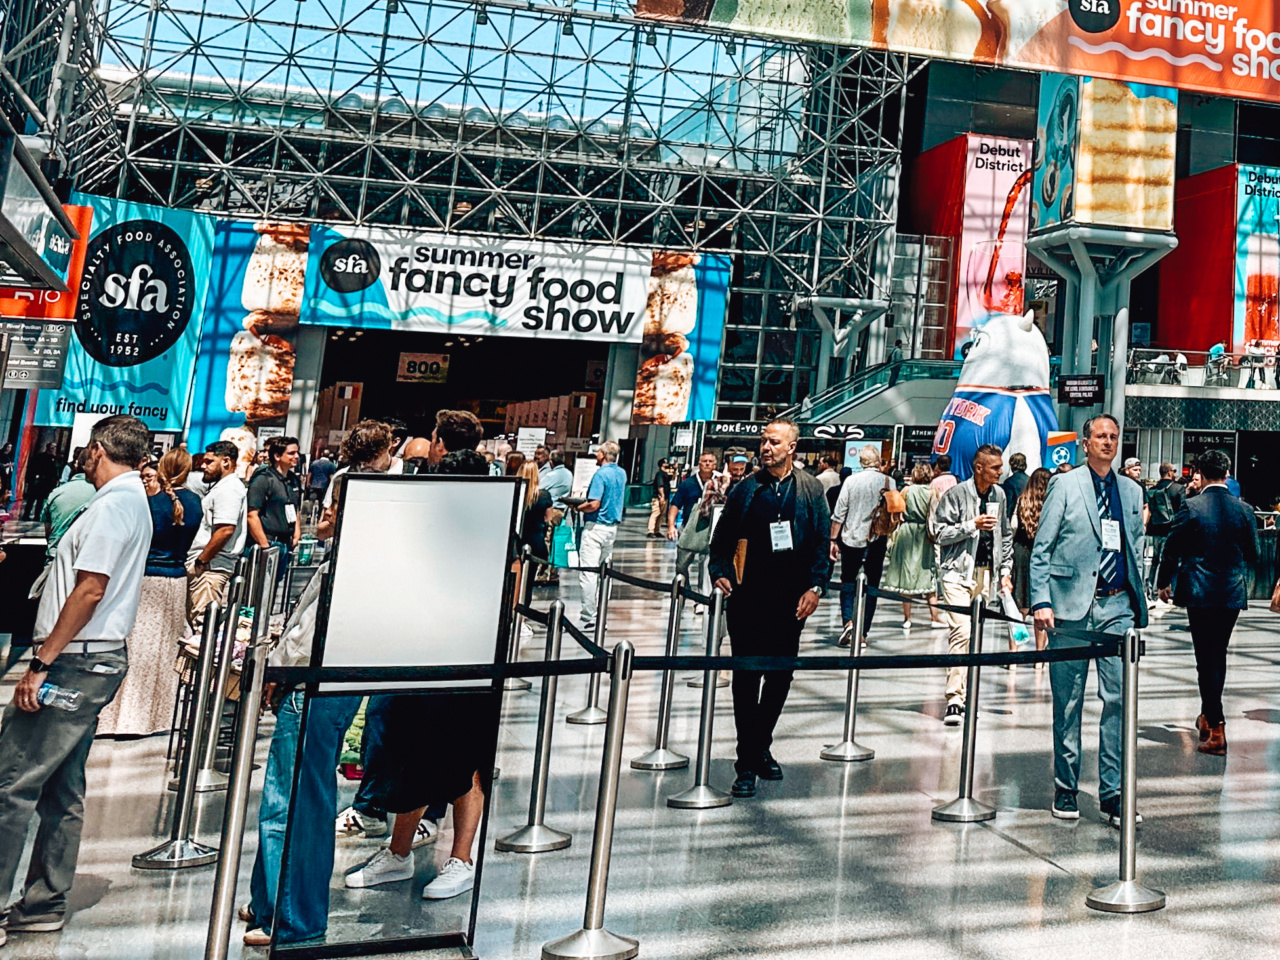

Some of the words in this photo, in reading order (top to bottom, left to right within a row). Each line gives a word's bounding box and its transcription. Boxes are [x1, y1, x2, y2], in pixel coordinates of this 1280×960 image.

[1126, 1, 1225, 55] fancy
[979, 142, 1022, 158] Debut
[974, 156, 1024, 173] District
[332, 253, 369, 274] sfa
[414, 245, 535, 271] summer
[81, 243, 110, 320] SPECIALTY
[117, 231, 153, 245] FOOD
[157, 239, 186, 330] ASSOCIATION
[98, 263, 170, 313] sfa
[389, 257, 517, 308] fancy
[527, 267, 623, 305] food
[521, 297, 635, 335] show
[116, 333, 138, 343] EST
[110, 345, 139, 356] 1952
[405, 359, 441, 375] 800
[56, 398, 85, 413] find
[128, 401, 169, 421] fancy
[948, 397, 991, 427] YORK
